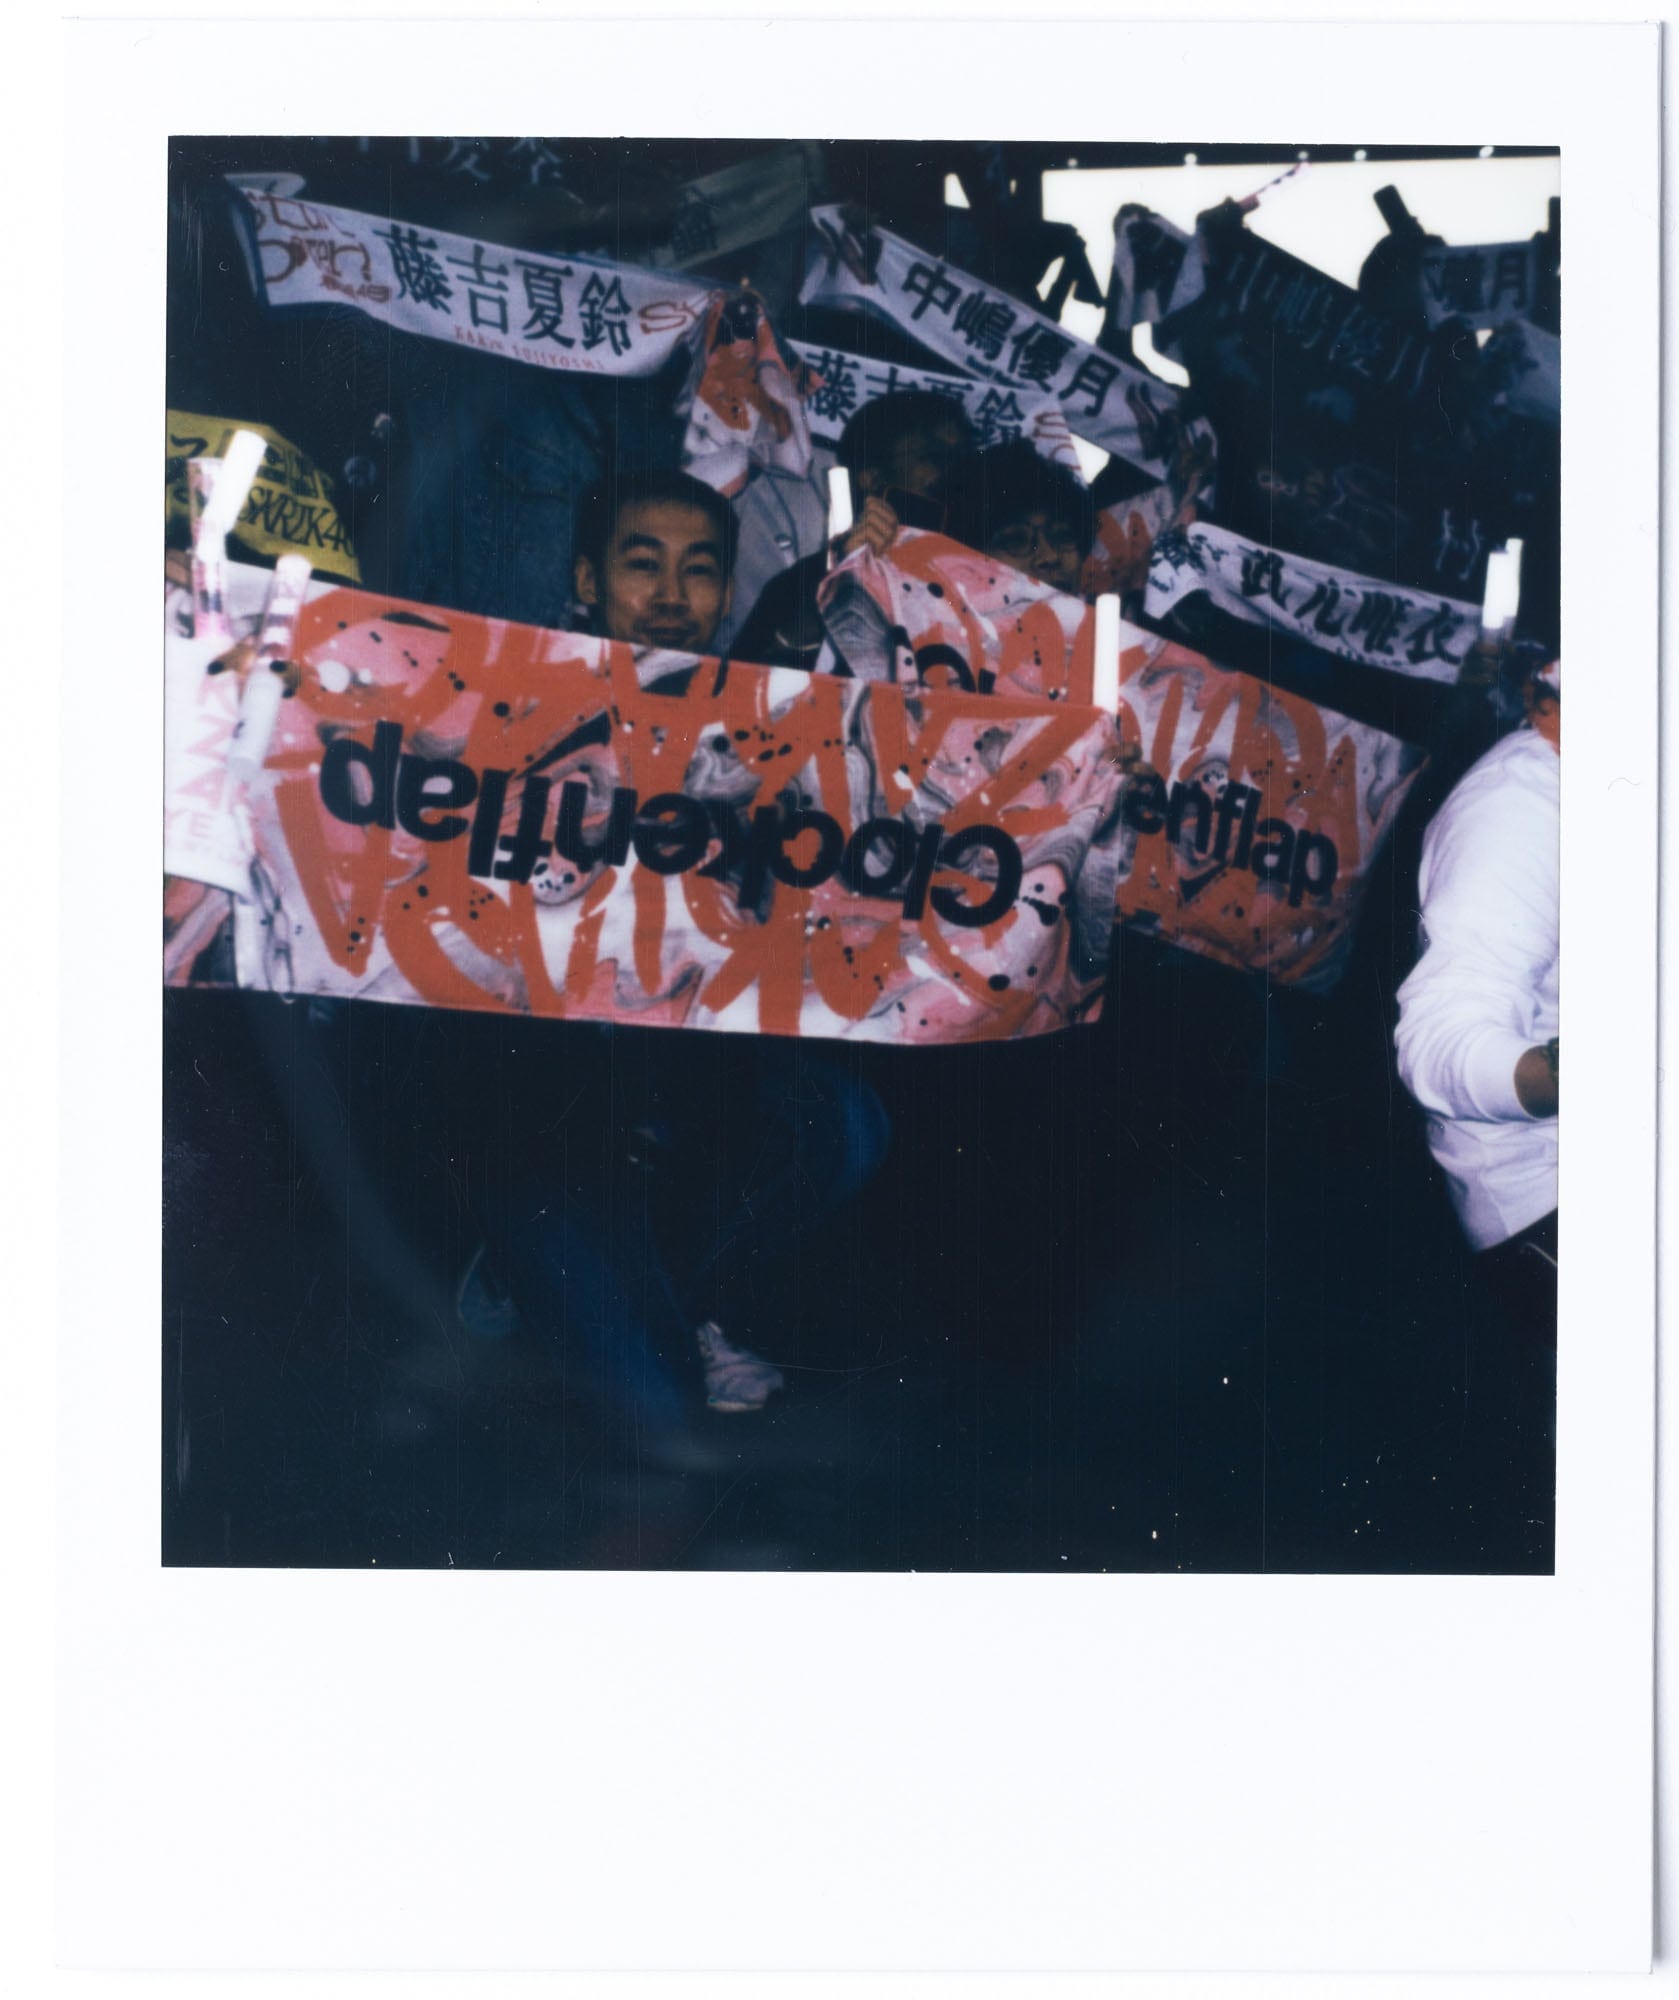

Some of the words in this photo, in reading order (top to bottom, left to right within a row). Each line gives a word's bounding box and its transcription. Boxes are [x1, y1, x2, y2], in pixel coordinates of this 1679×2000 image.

[373, 222, 632, 358] 藤吉夏鈴
[901, 261, 1121, 417] 中嶋優月
[319, 719, 1024, 927] Clockenflap
